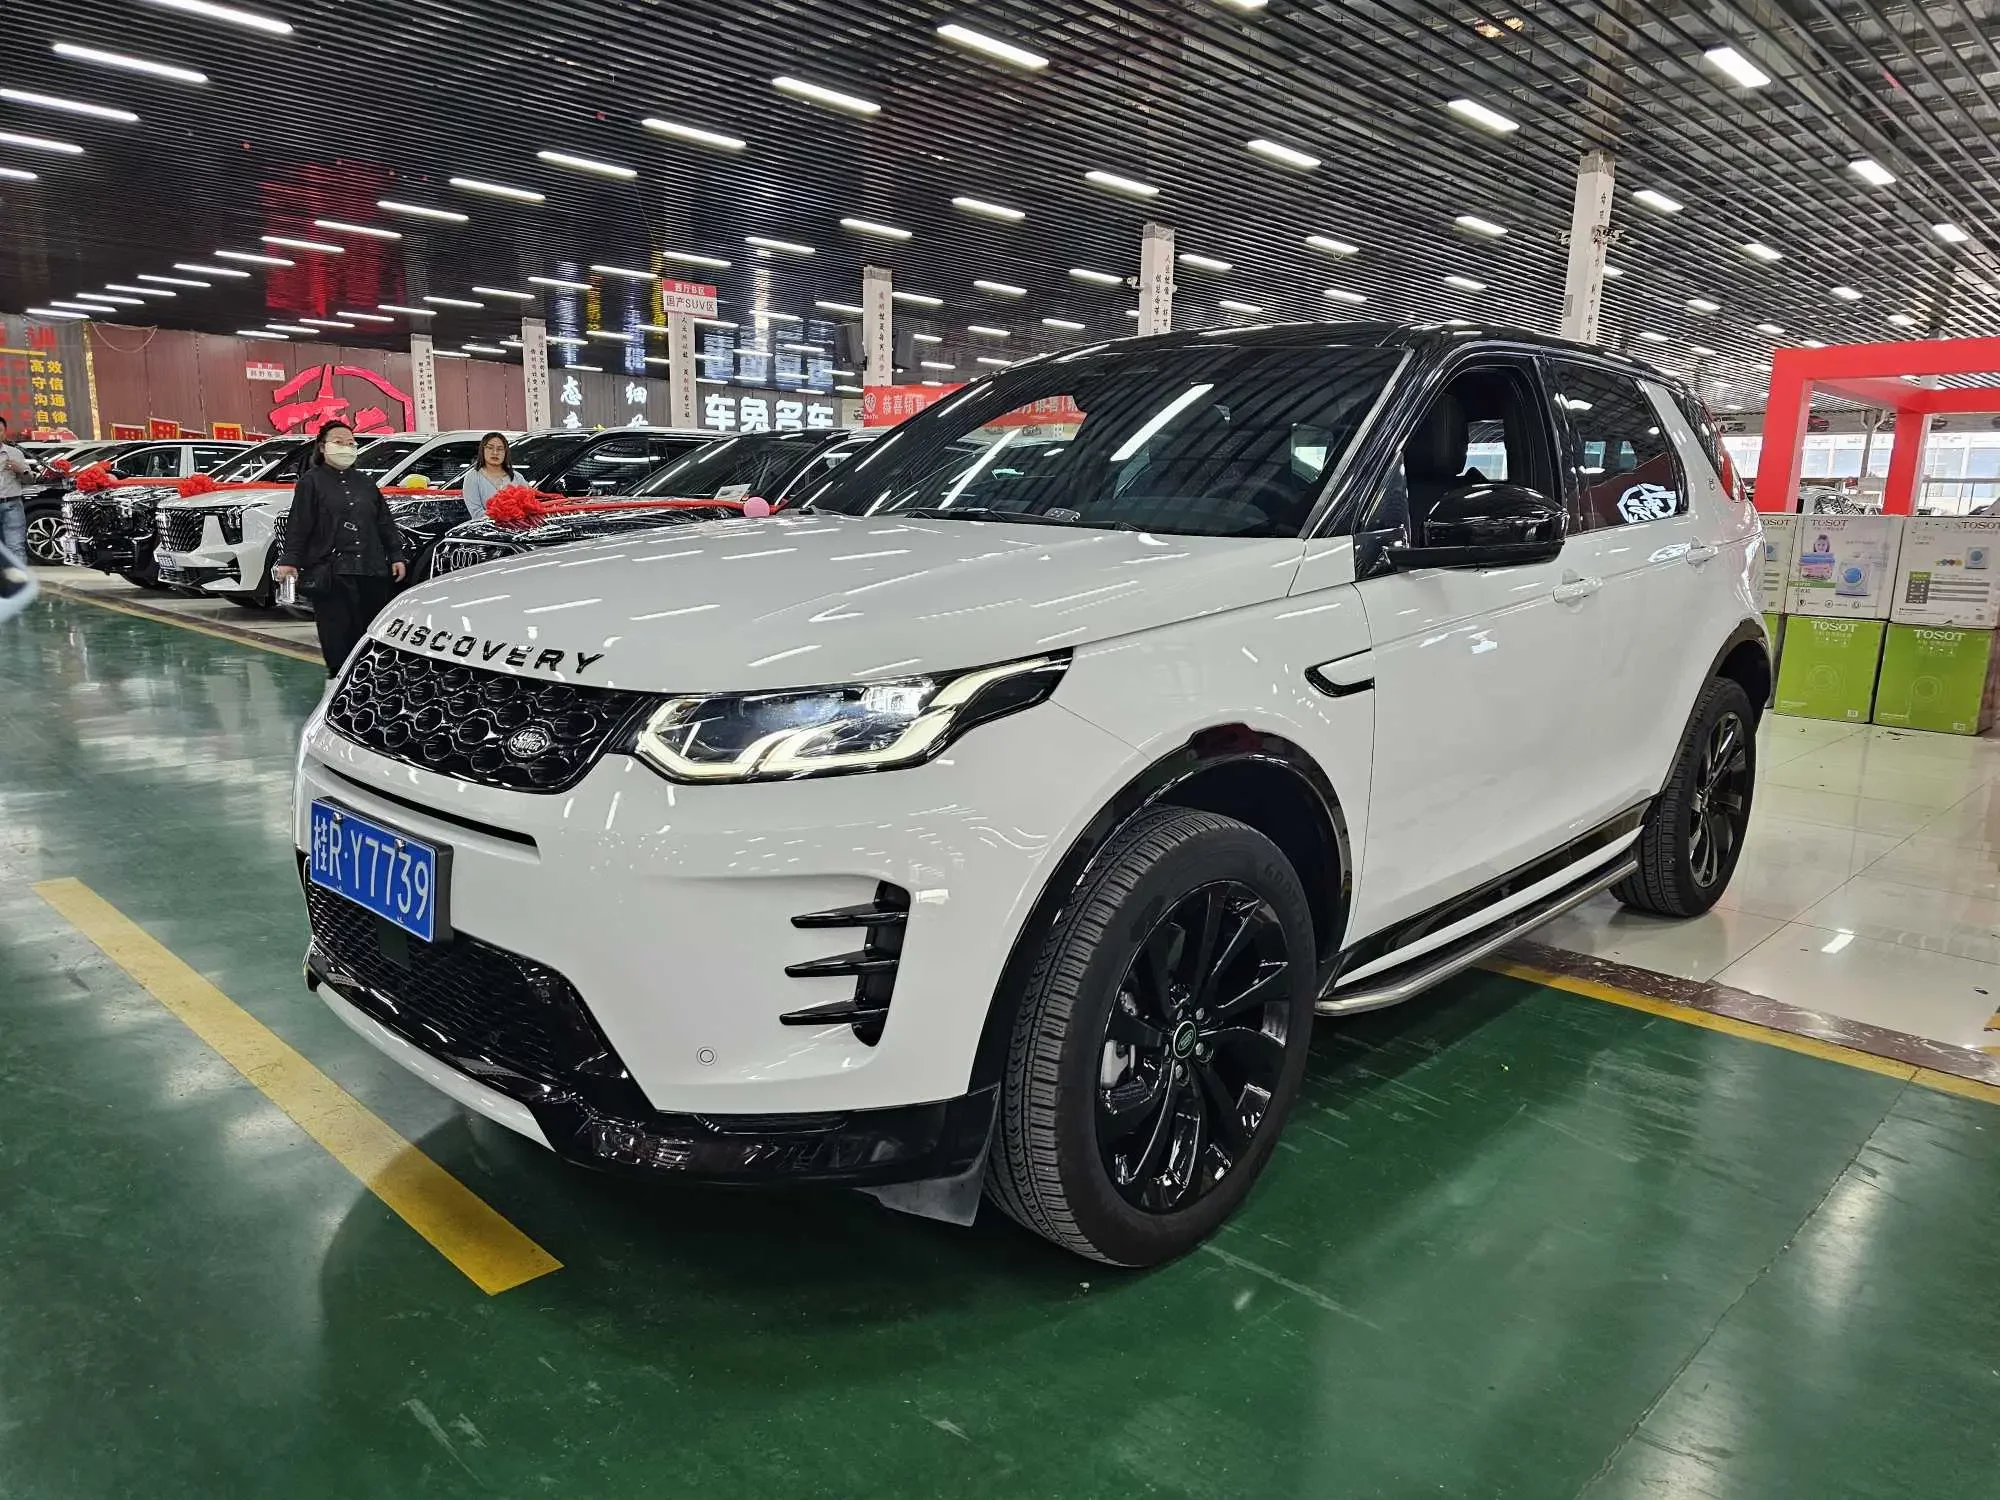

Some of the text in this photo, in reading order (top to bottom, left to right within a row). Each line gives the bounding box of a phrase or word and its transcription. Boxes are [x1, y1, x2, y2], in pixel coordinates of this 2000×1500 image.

[666, 295, 714, 312] 国产SUV区
[30, 359, 63, 374] 高效
[32, 377, 64, 391] 守信
[33, 393, 66, 407] 沟通
[35, 410, 68, 424] 自律
[1761, 519, 1791, 527] OSOT
[1810, 519, 1849, 528] TOSOT
[1810, 620, 1859, 633] TOSOT
[1913, 629, 1967, 642] TOSOT
[387, 618, 604, 674] DISCOVERY
